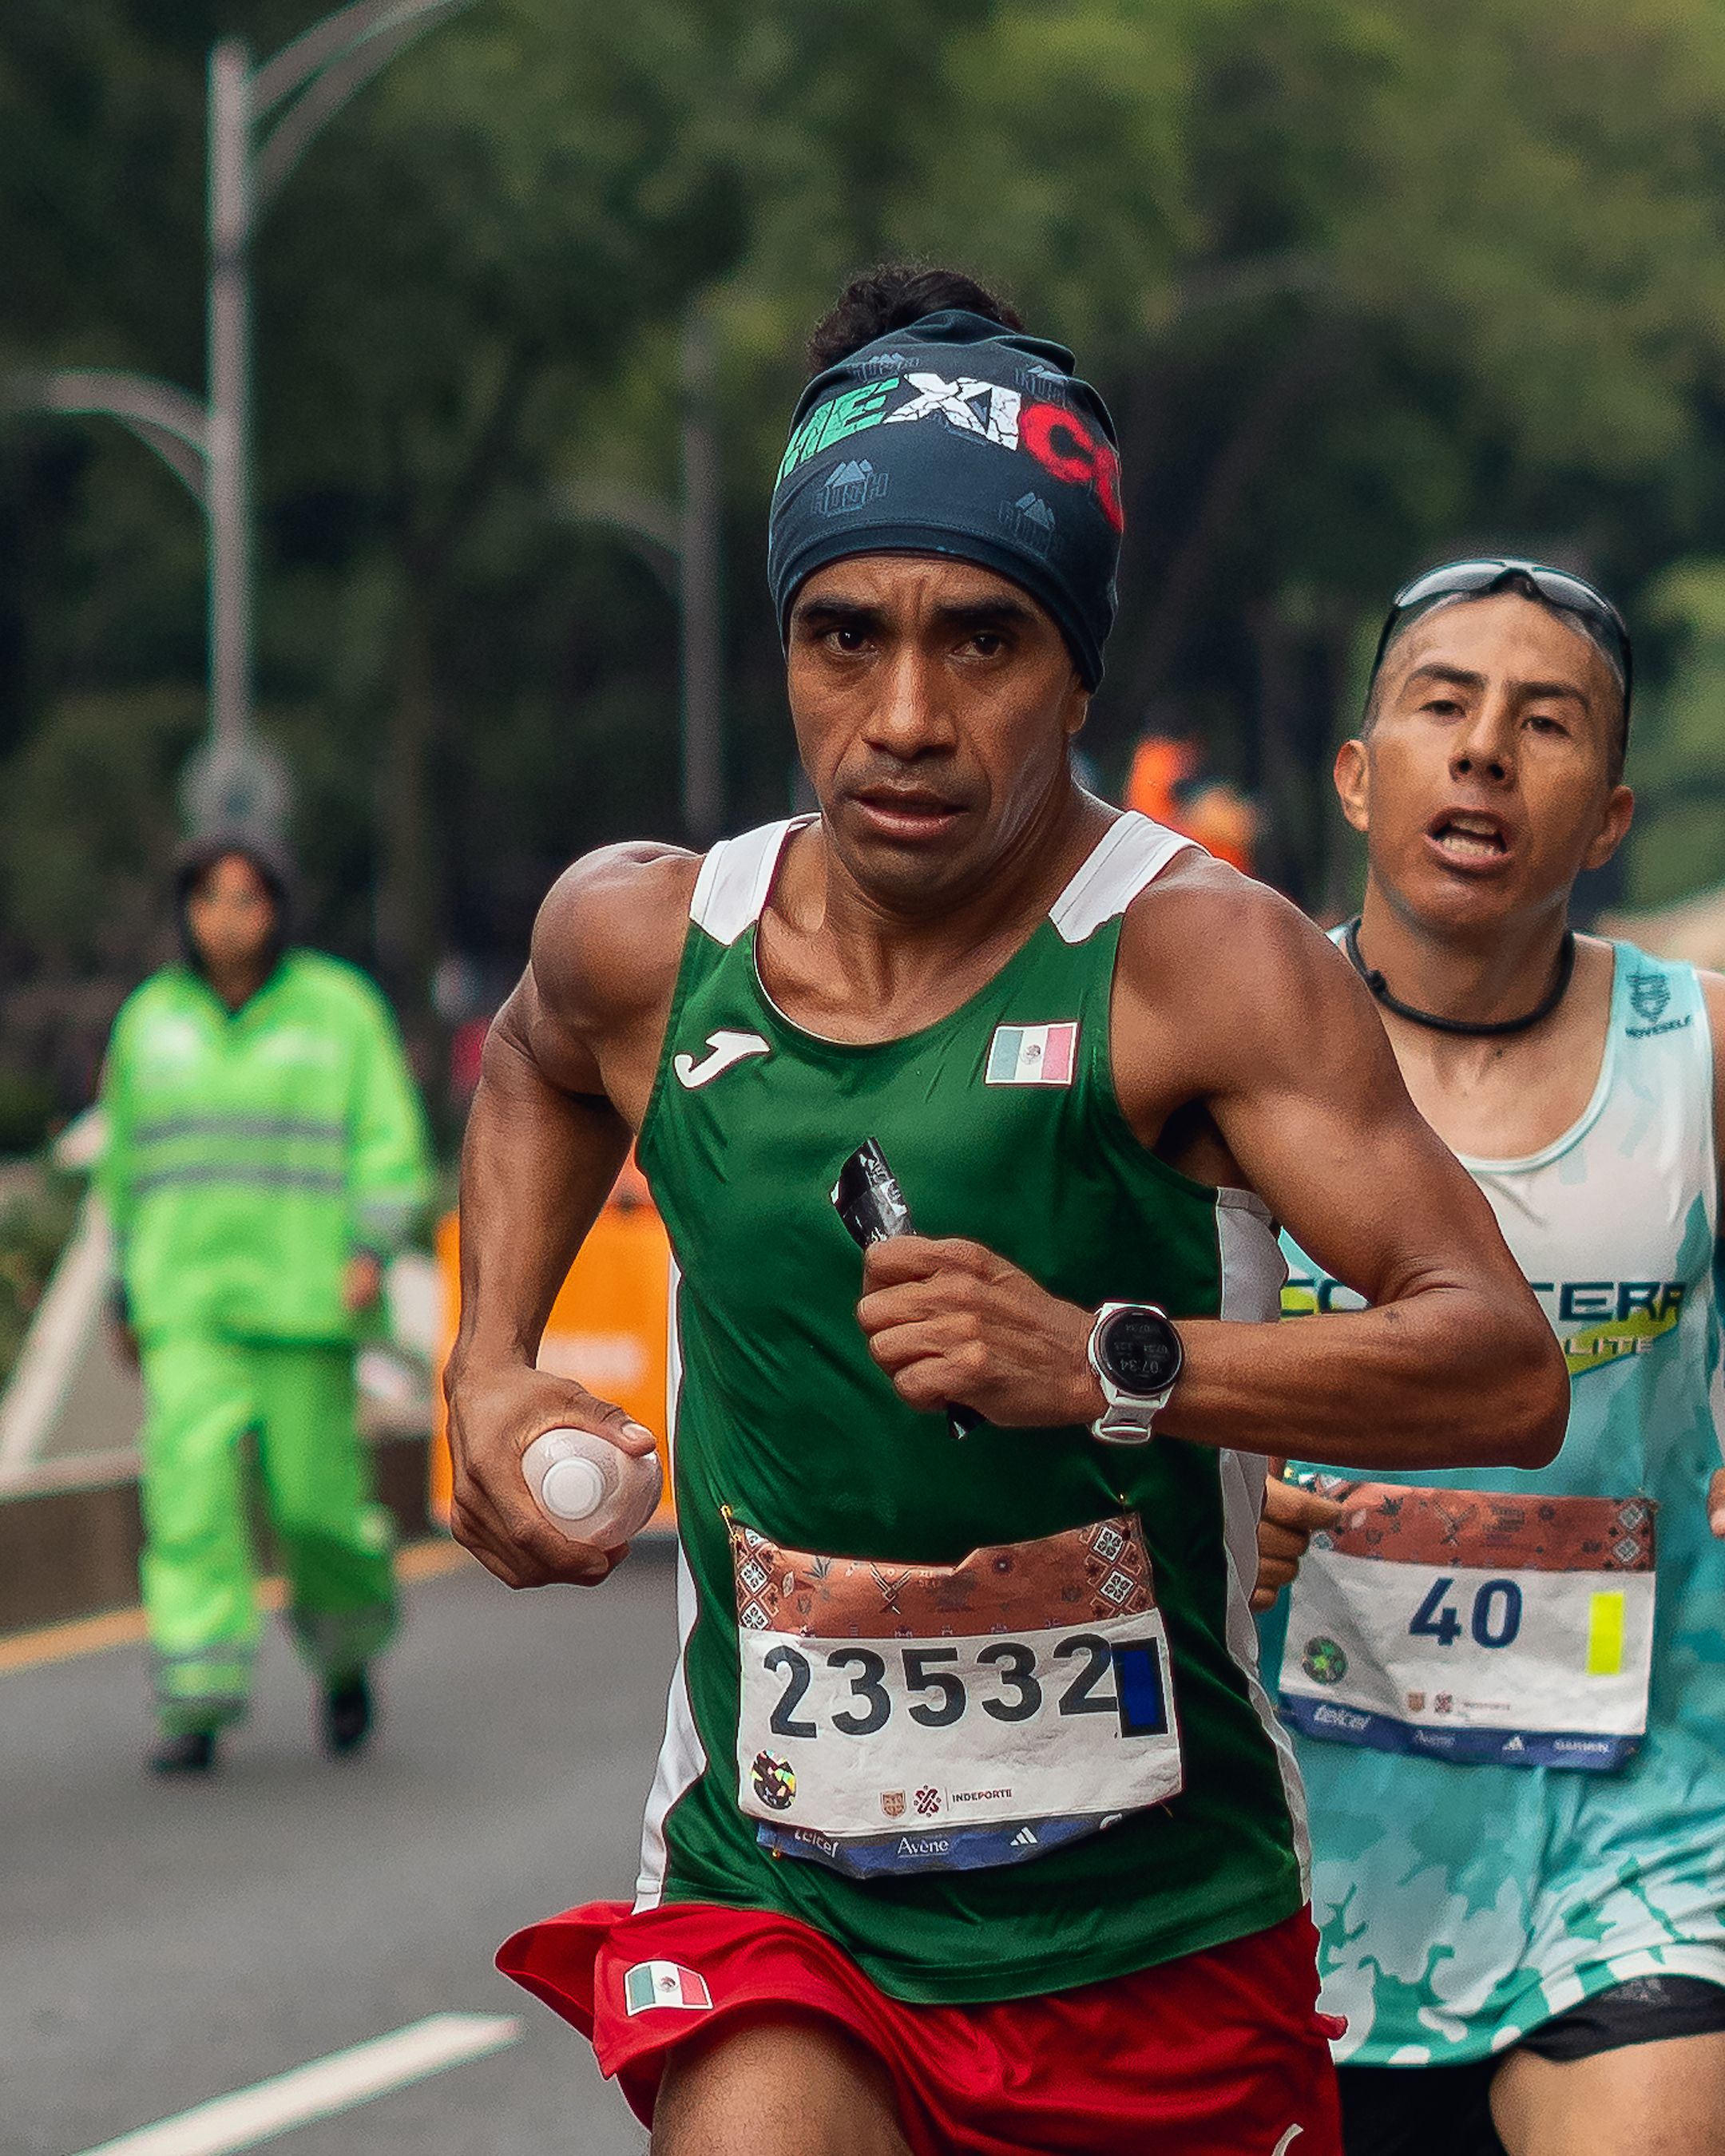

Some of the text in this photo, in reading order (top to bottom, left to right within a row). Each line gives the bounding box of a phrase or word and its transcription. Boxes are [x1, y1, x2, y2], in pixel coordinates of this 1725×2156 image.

[772, 372, 1124, 533] MEXIC
[1410, 1577, 1524, 1649] 40
[764, 1633, 1119, 1738] 23532
[952, 1789, 1013, 1804] INDEPORTE
